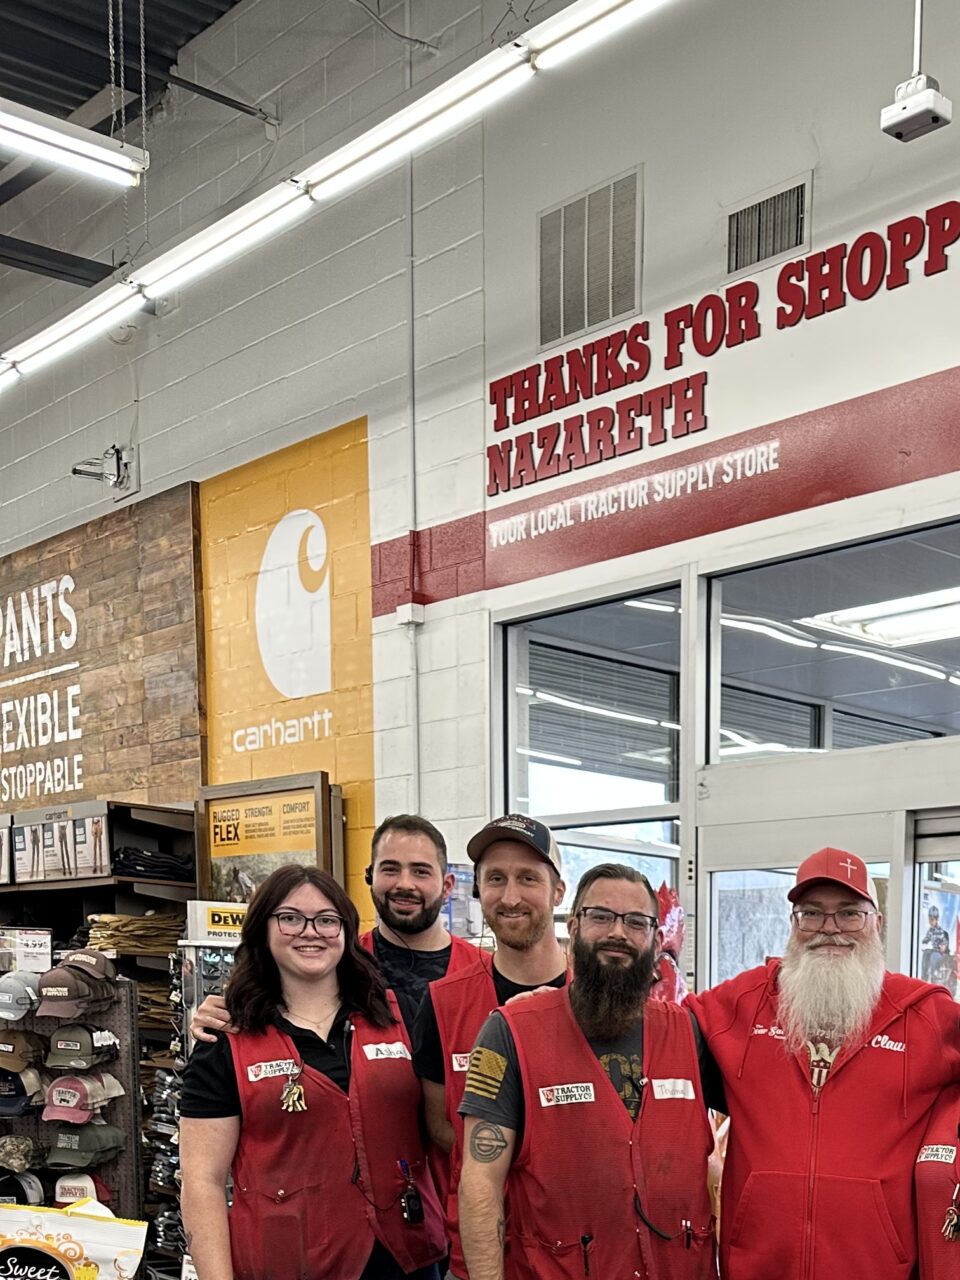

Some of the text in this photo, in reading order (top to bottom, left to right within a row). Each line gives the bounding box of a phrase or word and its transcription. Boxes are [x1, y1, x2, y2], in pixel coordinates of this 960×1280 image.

[490, 321, 650, 431] THANKS
[664, 280, 760, 370] FOR
[487, 371, 707, 496] NAZARETH
[489, 439, 780, 547] YOUR LOCAL TRACTOR SUPPLY STORE
[0, 575, 78, 667] ANTS
[0, 684, 82, 753] EXIBLE
[233, 708, 332, 753] carhartt
[1, 754, 83, 801] STOPPABLE
[213, 809, 240, 823] RUGGED
[244, 801, 310, 818] STRENGTH COMFORT
[213, 822, 240, 843] FLEX
[555, 1085, 591, 1095] TRACTOR
[555, 1093, 583, 1103] SUPPLY
[0, 1257, 59, 1280] Sweet
